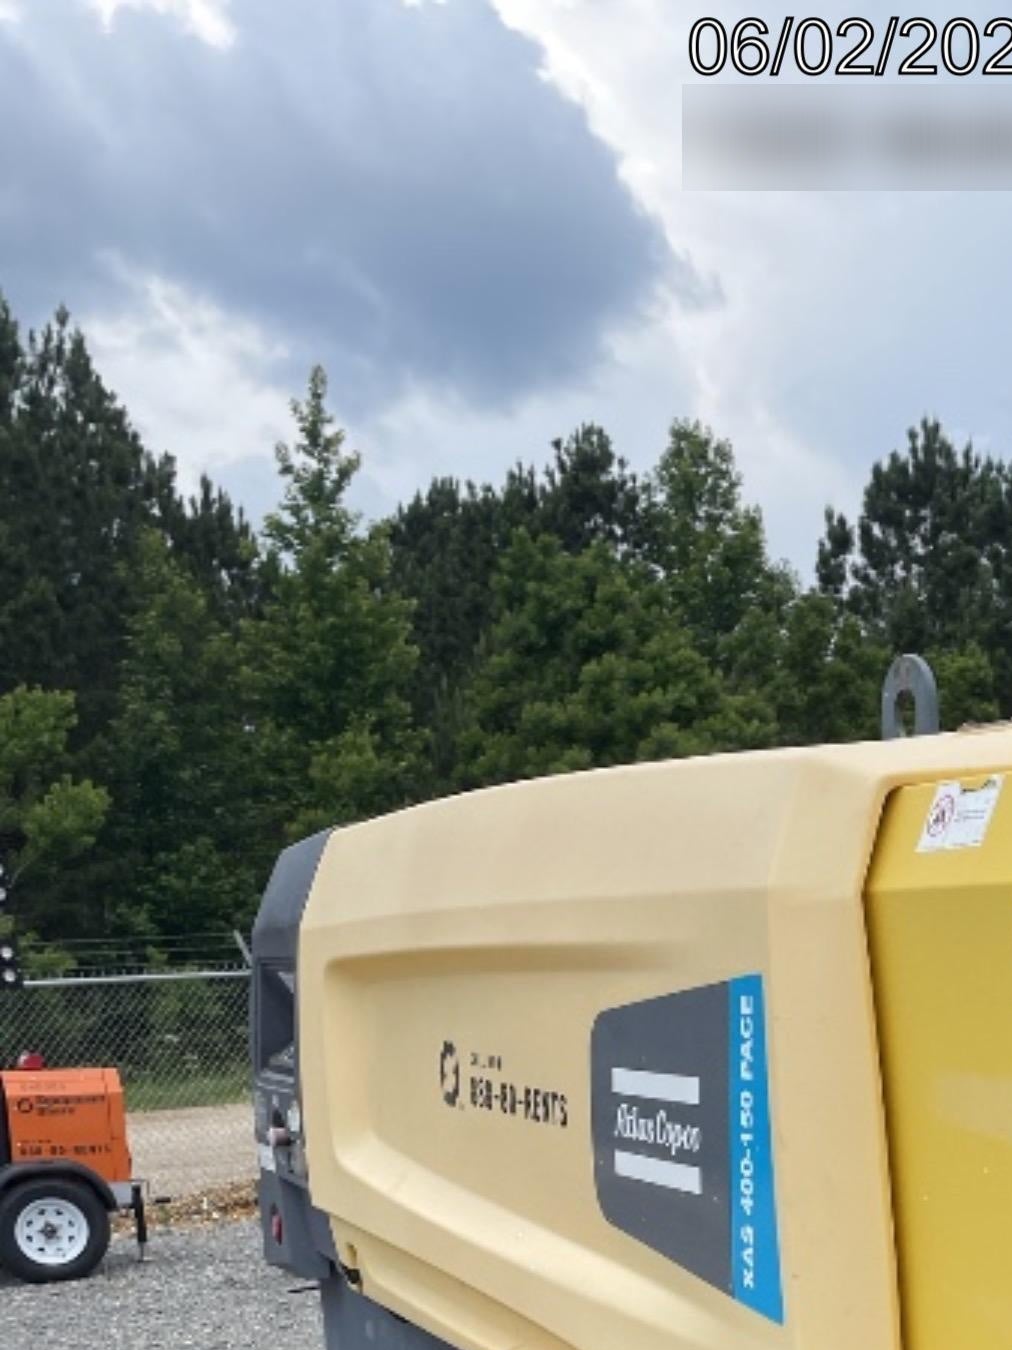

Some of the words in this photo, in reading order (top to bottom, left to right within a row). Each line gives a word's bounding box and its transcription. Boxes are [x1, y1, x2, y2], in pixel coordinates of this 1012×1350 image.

[740, 995, 754, 1081] PACE
[614, 1103, 654, 1144] Atlas
[656, 1109, 701, 1156] Copco
[740, 1090, 754, 1216] 400-150
[741, 1226, 755, 1289] XAS
